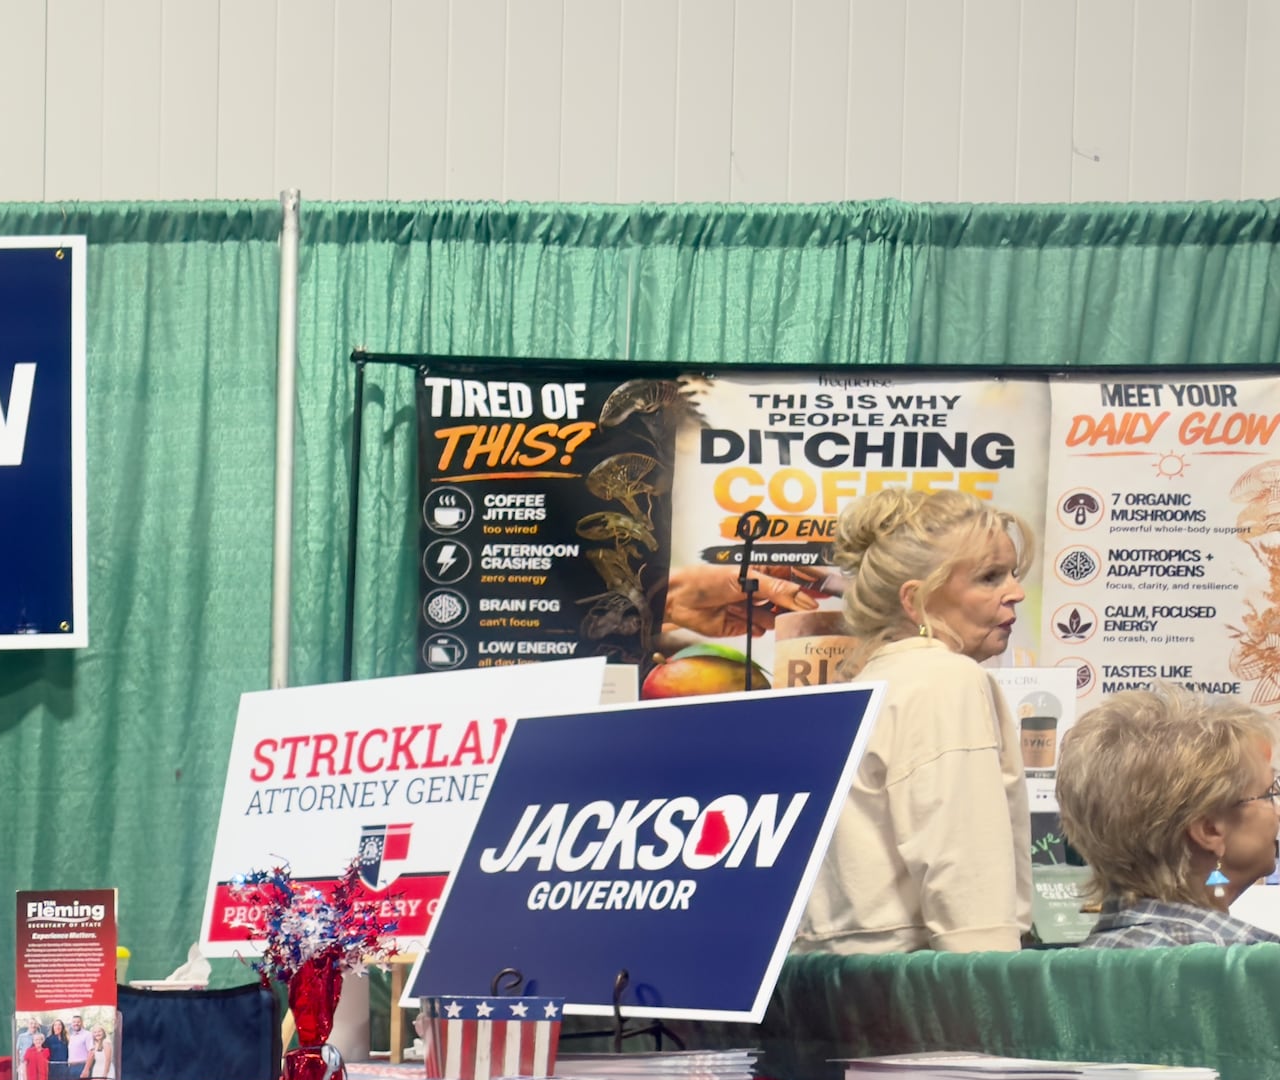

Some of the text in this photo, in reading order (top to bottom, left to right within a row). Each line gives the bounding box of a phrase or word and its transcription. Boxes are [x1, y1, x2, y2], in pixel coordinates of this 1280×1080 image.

[425, 377, 586, 420] TIRED OF
[749, 393, 960, 410] THIS IS WHY
[1101, 384, 1237, 407] MEET YOUR
[769, 412, 947, 428] PEOPLE ARE
[1065, 411, 1280, 447] DAILY GLOW
[433, 422, 597, 470] THIS?
[700, 429, 1015, 469] DITCHING
[483, 494, 546, 507] COFFEE
[1111, 493, 1191, 506] 7 ORGANIC
[482, 508, 546, 521] JITTERS
[1110, 509, 1206, 522] MUSHROOMS
[483, 524, 538, 534] too wired
[1109, 525, 1251, 535] powerful whole-body support
[481, 544, 579, 557] AFTERNOON
[1108, 549, 1214, 562] NOOTROPICS +
[481, 557, 552, 570] CRASHES
[734, 551, 818, 564] clm energy
[1107, 565, 1205, 577] ADAPTOGENS
[481, 575, 547, 585] zero energy
[1106, 582, 1239, 591] focus, clarity, and resilience
[480, 599, 560, 612] BRAIN FOG
[1105, 606, 1216, 620] CALM, FOCUSED
[480, 618, 540, 627] can't focus
[1104, 620, 1158, 632] ENERGY
[1119, 635, 1148, 643] crash,
[1165, 635, 1195, 645] jitters
[478, 641, 578, 655] LOW ENERGY
[478, 658, 493, 667] all
[1102, 665, 1192, 678] TASTES LIKE
[244, 779, 398, 817] ATTORNEY
[480, 792, 810, 873] JACKSON
[527, 880, 697, 910] GOVERNOR
[27, 901, 105, 921] Fleming
